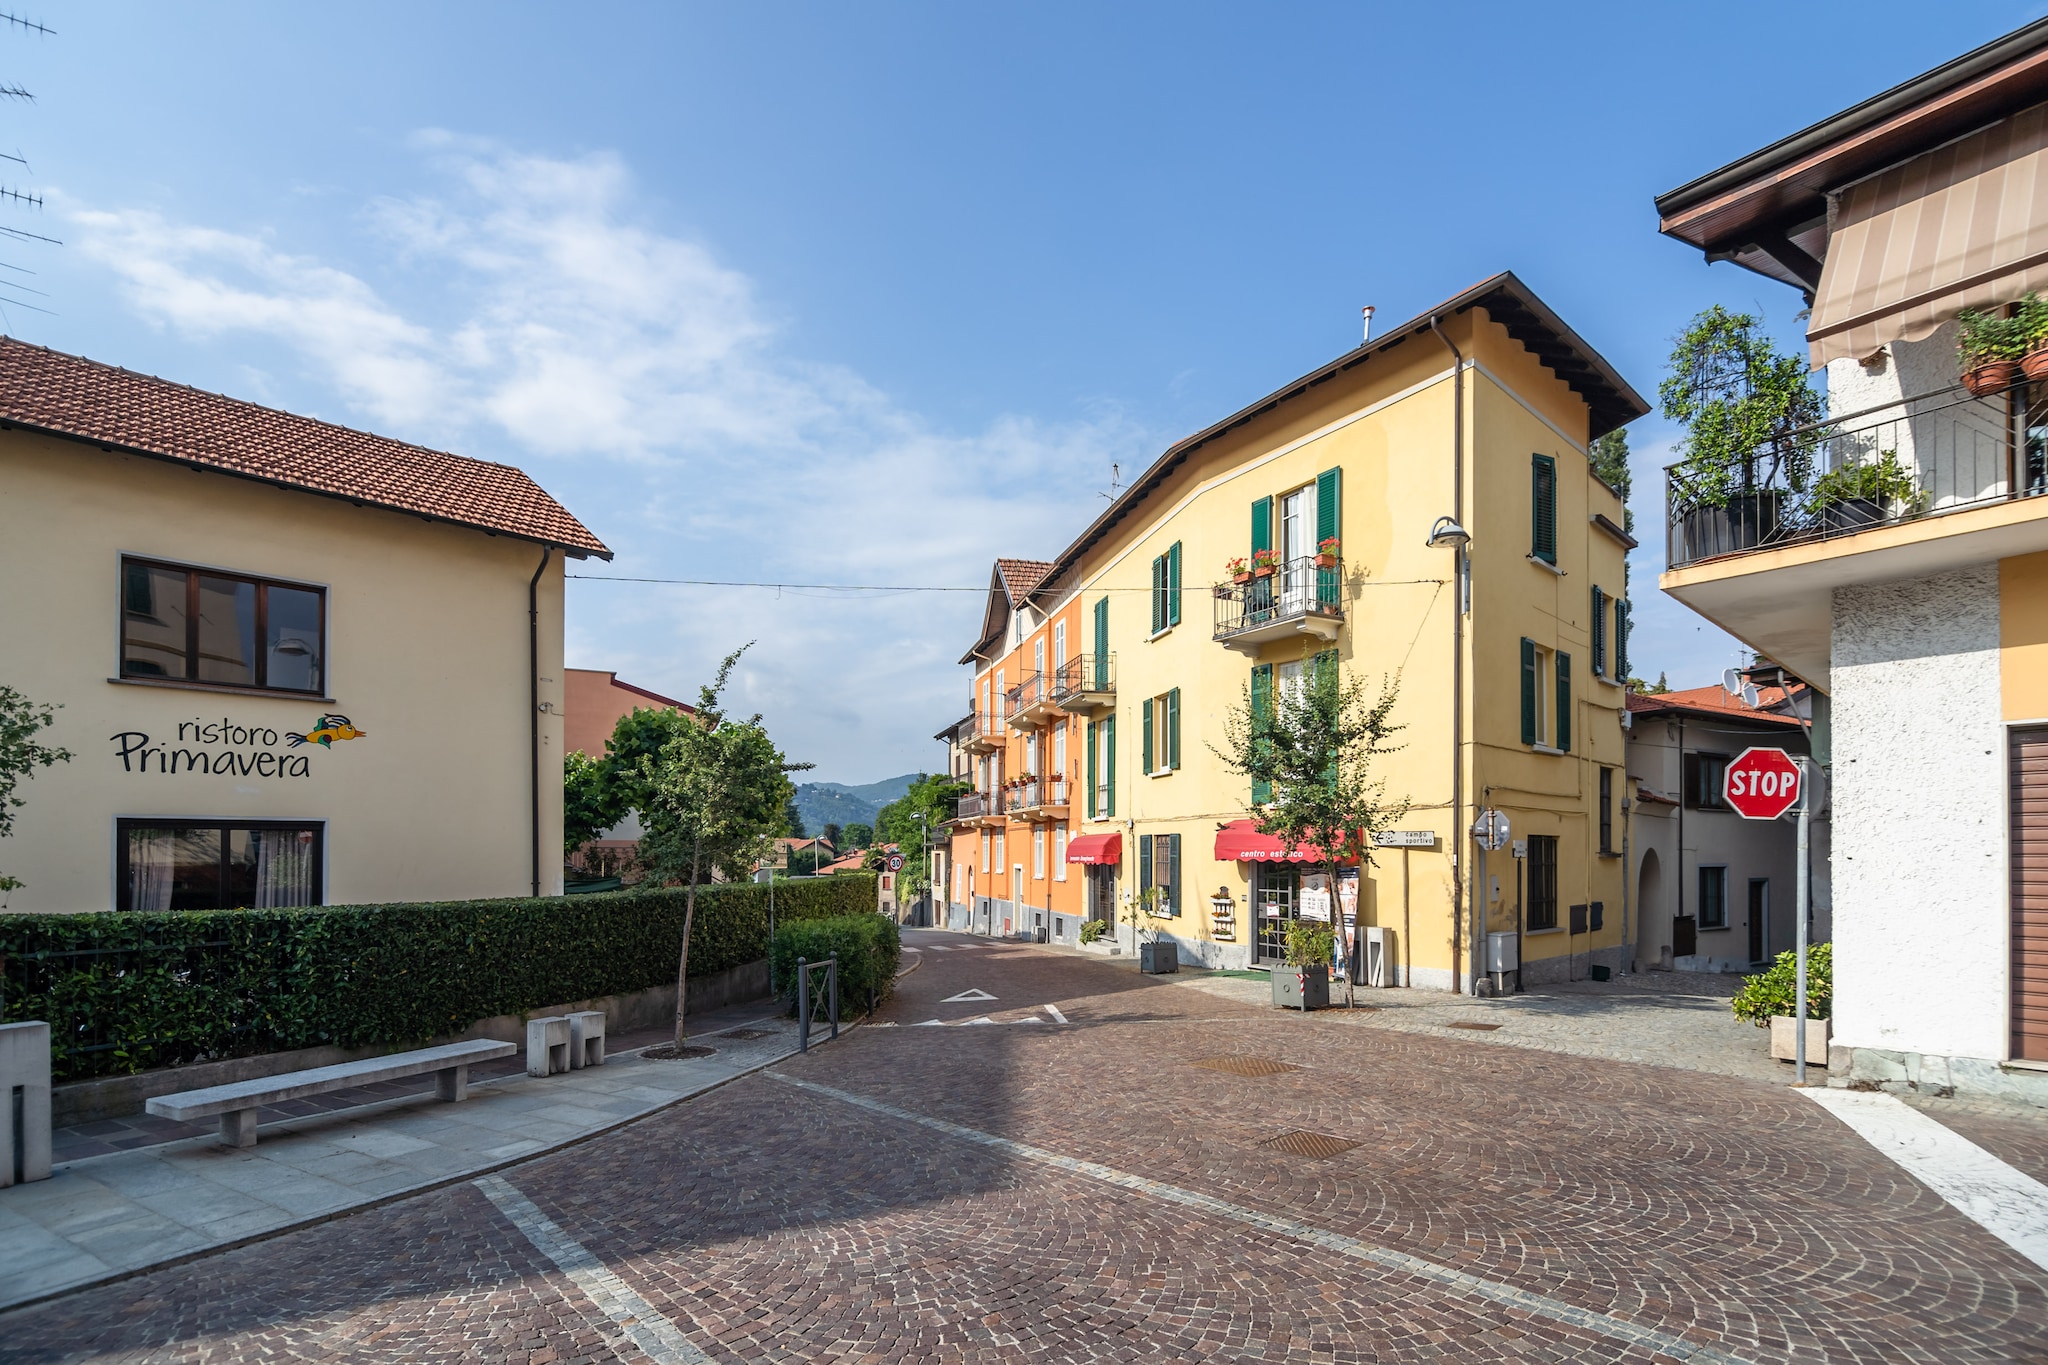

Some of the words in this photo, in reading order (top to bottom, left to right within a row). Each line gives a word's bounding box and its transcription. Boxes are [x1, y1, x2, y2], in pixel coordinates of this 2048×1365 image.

[178, 717, 278, 746] ristoro
[109, 731, 310, 778] Primavera
[1730, 769, 1796, 797] STOP
[891, 859, 901, 868] 30
[1240, 850, 1265, 858] centro
